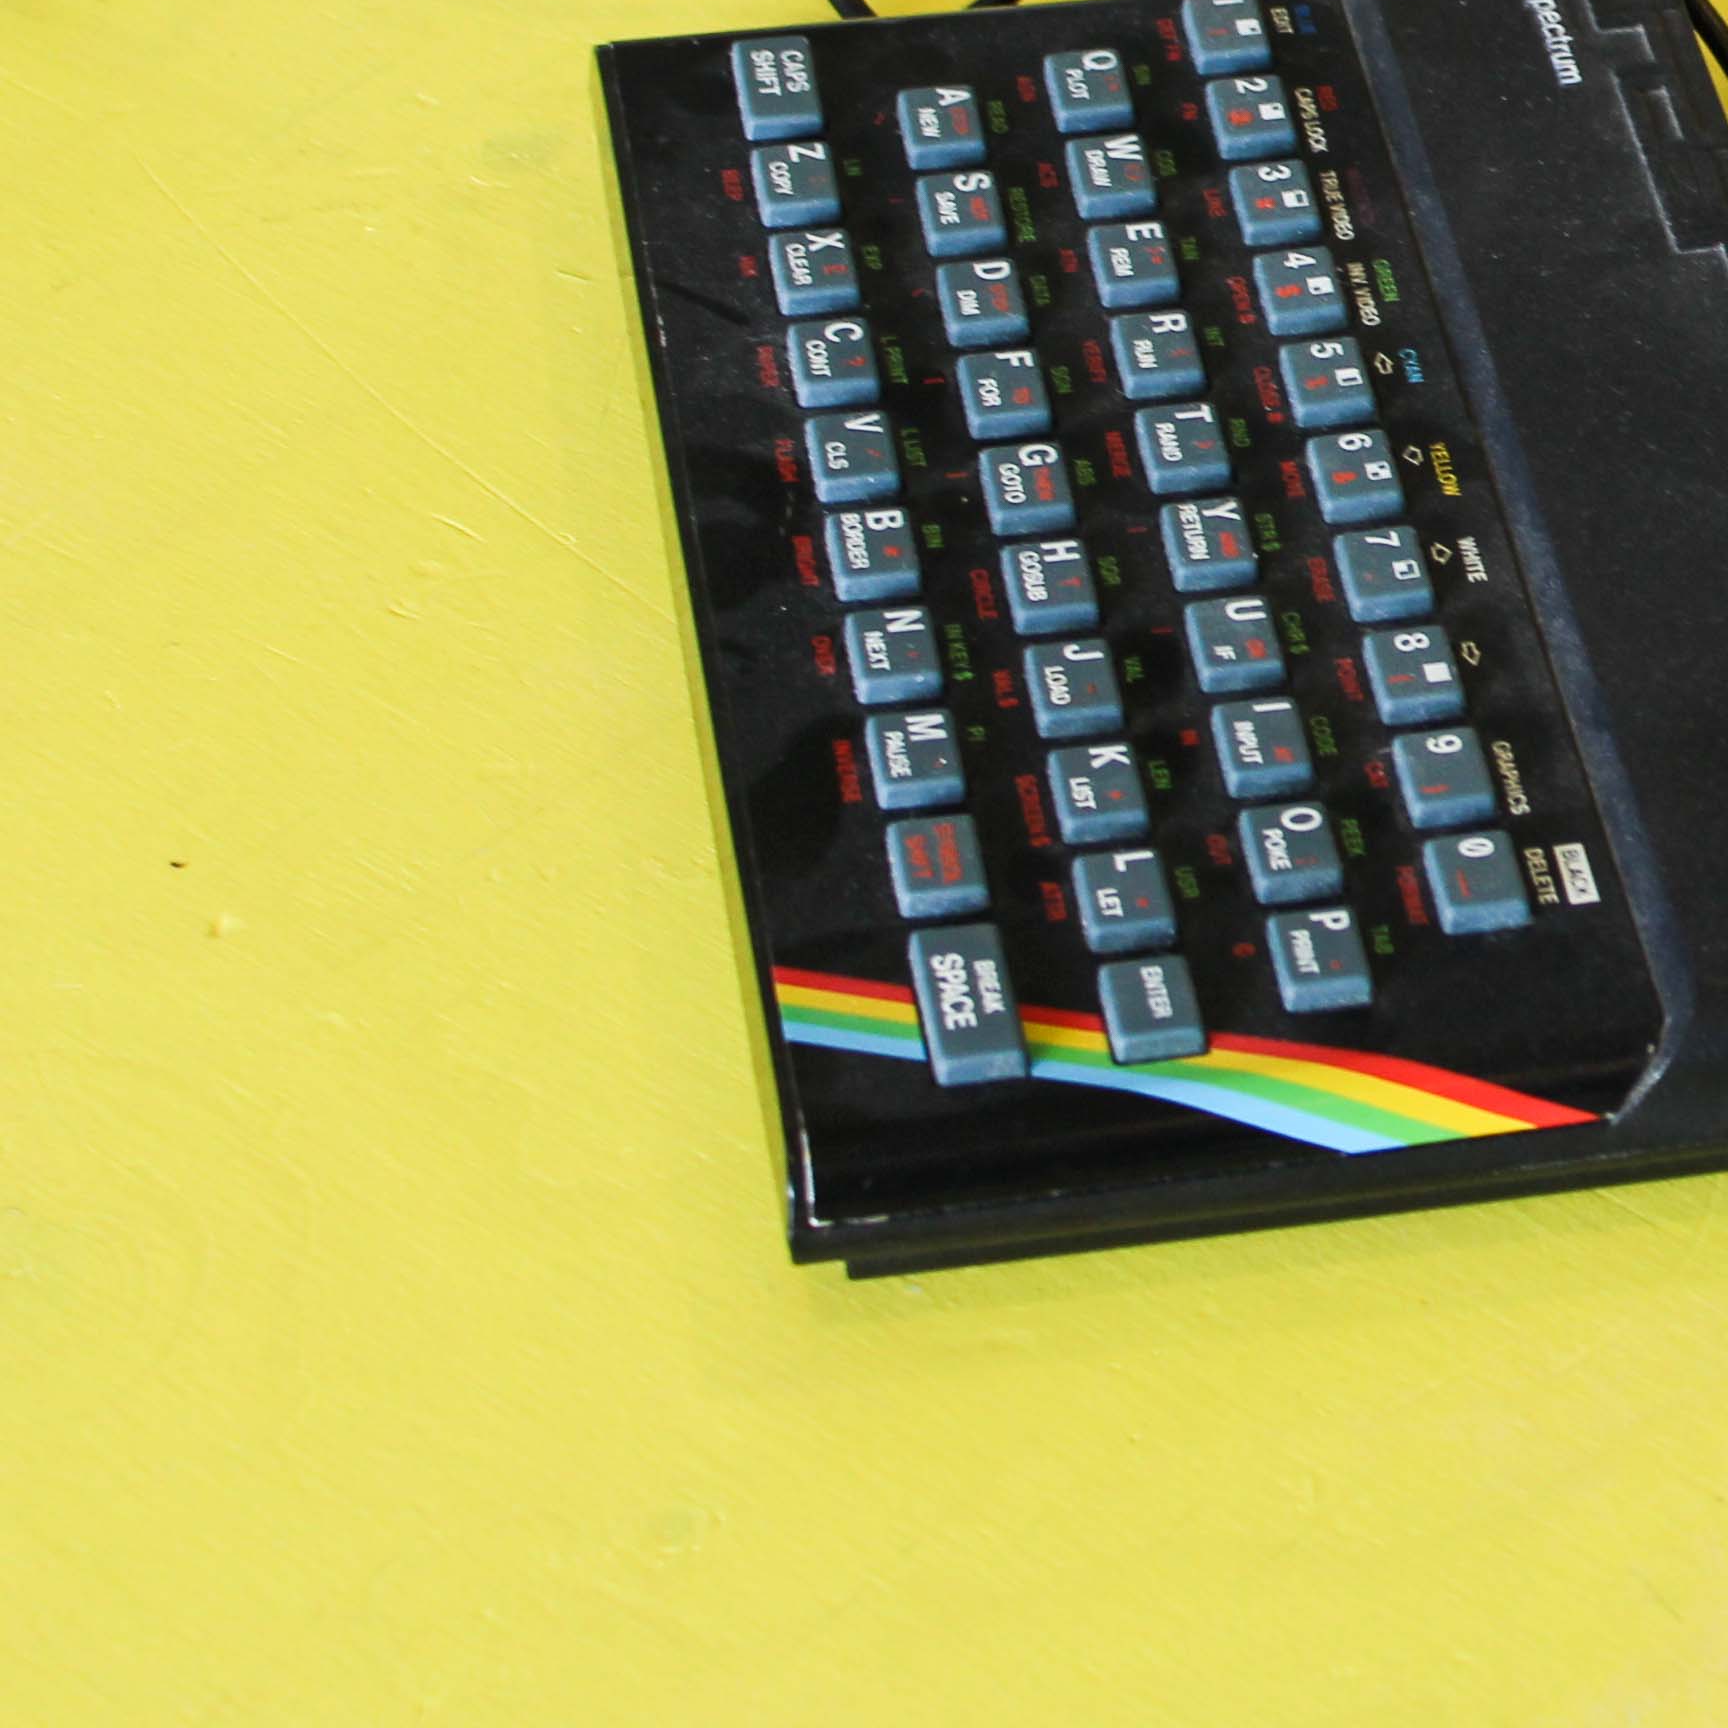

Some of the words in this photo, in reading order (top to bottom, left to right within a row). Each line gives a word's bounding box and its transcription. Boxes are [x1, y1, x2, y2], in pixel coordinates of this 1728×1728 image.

[1270, 8, 1292, 34] EDIT
[750, 49, 780, 96] SHIFT
[779, 49, 809, 92] CAPS
[1080, 49, 1118, 71] Q
[936, 86, 970, 105] A
[1065, 69, 1088, 100] PLOT
[1234, 77, 1266, 93] 2
[1294, 88, 1317, 118] CAPS
[917, 107, 940, 138] NEW
[1305, 121, 1327, 152] LOCK
[787, 143, 824, 162] Z
[1104, 134, 1141, 162] W
[768, 161, 791, 195] COPY
[953, 172, 991, 191] S
[1085, 150, 1110, 186] DRAW
[1258, 165, 1291, 182] 3
[1319, 171, 1342, 201] TRUE
[934, 192, 959, 224] SAVE
[1125, 222, 1162, 240] E
[1329, 205, 1354, 240] VIDEO
[806, 230, 844, 251] X
[786, 243, 811, 285] CLEAR
[973, 261, 1011, 280] D
[1109, 248, 1132, 276] REM
[1282, 252, 1315, 269] 4
[1372, 259, 1398, 301] GREEN
[957, 290, 979, 314] DIM
[1354, 288, 1379, 324] VIDEO
[823, 321, 864, 342] C
[1149, 313, 1187, 333] R
[805, 339, 830, 377] CONT
[995, 351, 1033, 369] F
[1132, 339, 1156, 368] RUN
[1309, 342, 1343, 358] 5
[1398, 349, 1422, 382] CYAN
[977, 378, 1000, 406] FOR
[843, 414, 882, 435] V
[1173, 405, 1211, 424] T
[825, 442, 847, 469] CLS
[1017, 443, 1058, 466] G
[1155, 422, 1181, 461] RAND
[1337, 433, 1372, 450] 6
[998, 463, 1025, 503] GOTO
[1428, 442, 1460, 496] YELLOW
[864, 509, 904, 531] B
[1201, 502, 1239, 522] Y
[840, 512, 869, 569] BORDER
[1177, 503, 1208, 559] RETURN
[1364, 531, 1400, 548] 7
[1041, 540, 1080, 562] H
[1457, 537, 1486, 582] WHITE
[1018, 551, 1047, 600] GOSUB
[884, 609, 924, 633] N
[1224, 599, 1265, 621] U
[864, 631, 888, 671] NEXT
[1062, 642, 1103, 661] J
[1213, 645, 1235, 661] IF
[1393, 633, 1429, 651] 8
[1044, 666, 1070, 704] LOAD
[1252, 701, 1291, 712] I
[905, 713, 946, 741] M
[883, 731, 909, 776] PAUSE
[1233, 721, 1261, 763] INPUT
[1425, 735, 1463, 754] 9
[1088, 745, 1129, 768] K
[1492, 741, 1529, 814] GRAPHICS
[1069, 777, 1094, 809] LIST
[1279, 806, 1323, 832] O
[1114, 851, 1154, 871] L
[1262, 828, 1291, 869] POKE
[1525, 849, 1557, 904] DELETE
[1562, 849, 1589, 895] BLACK
[1096, 888, 1121, 917] LET
[1309, 910, 1351, 932] P
[1289, 929, 1318, 973] PRINT
[929, 952, 976, 1030] SPACE
[973, 959, 1003, 1012] BREAK
[1140, 966, 1171, 1018] ENTER
